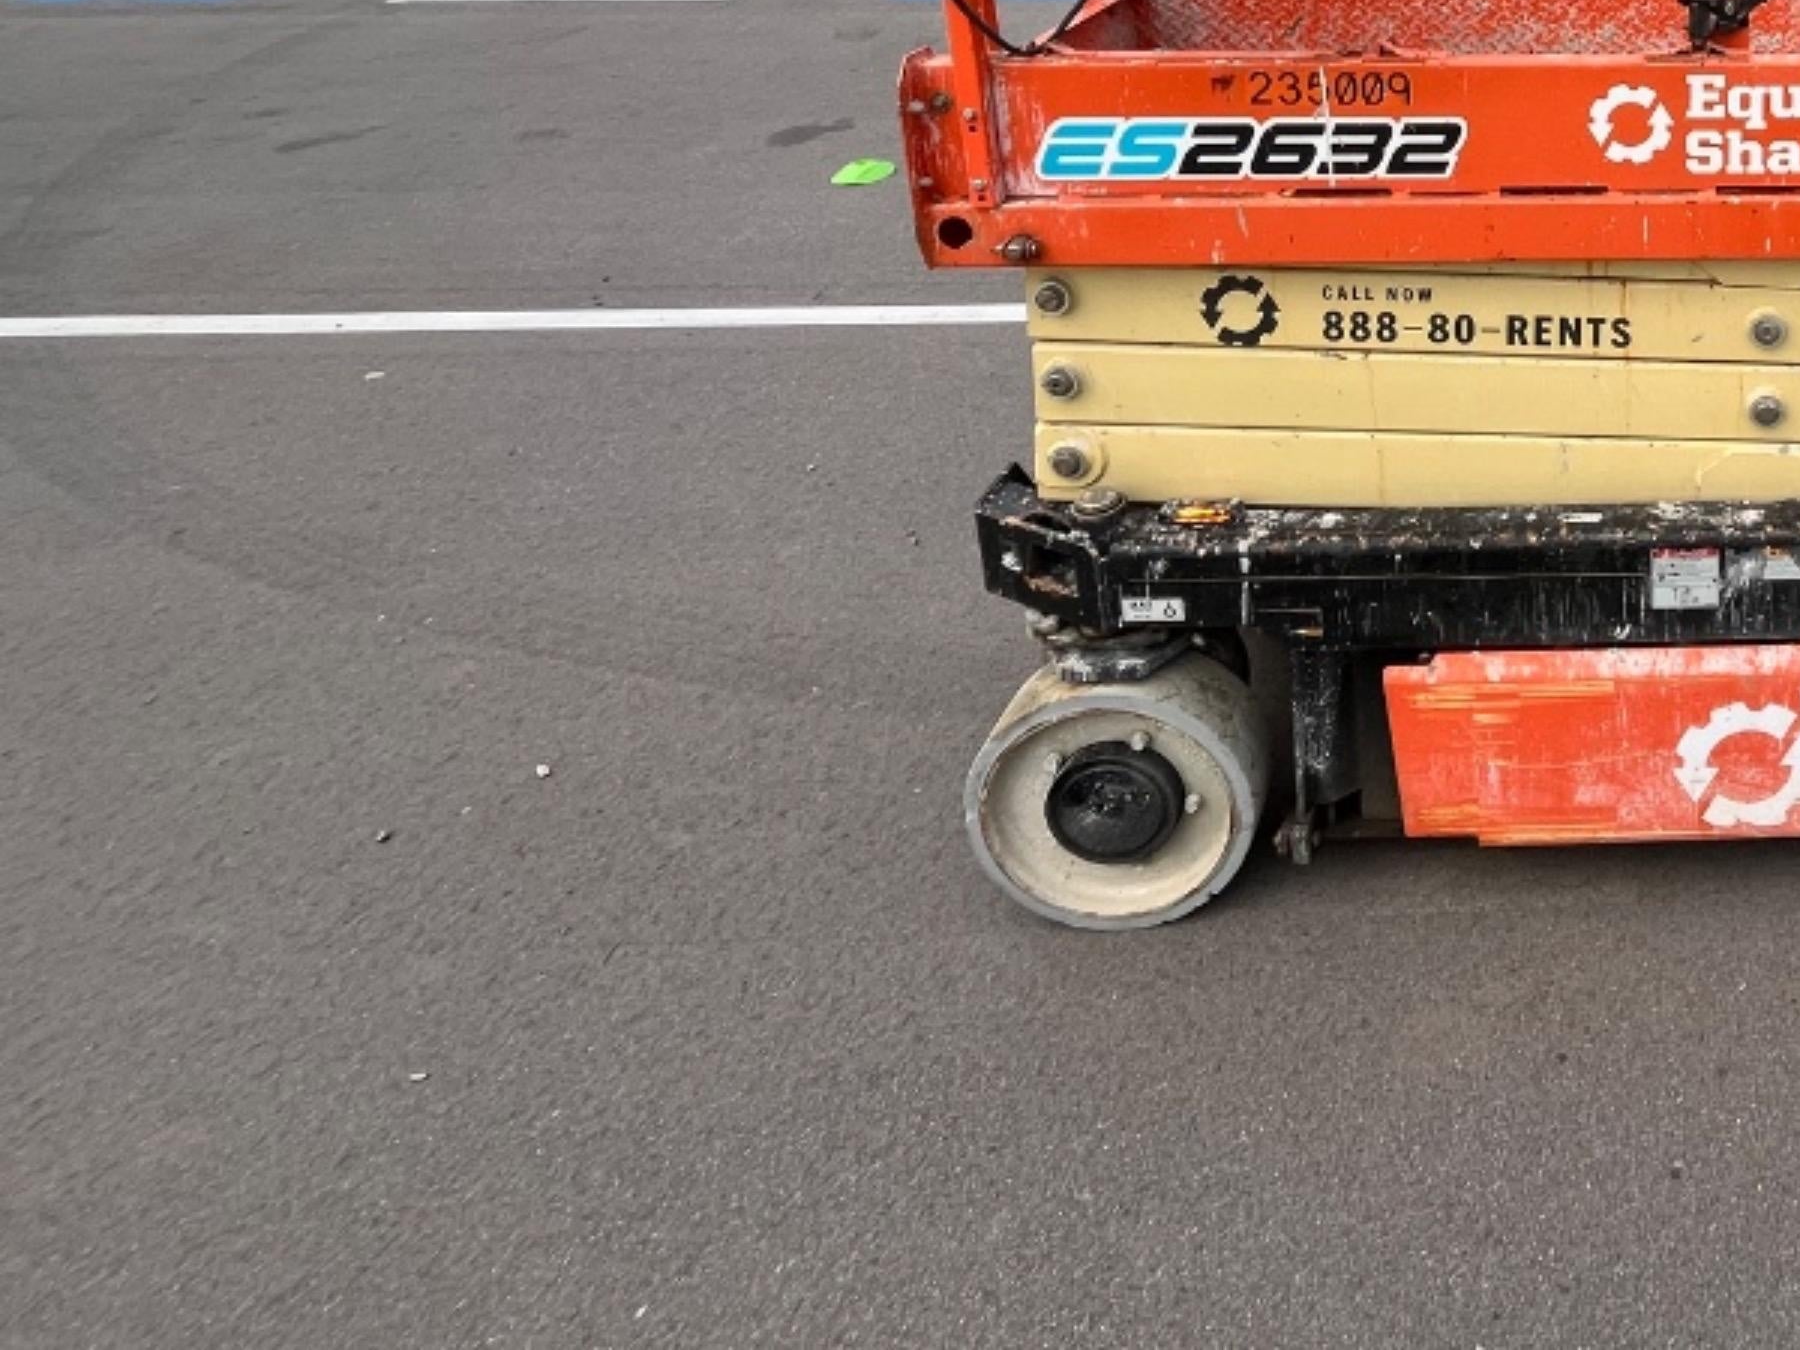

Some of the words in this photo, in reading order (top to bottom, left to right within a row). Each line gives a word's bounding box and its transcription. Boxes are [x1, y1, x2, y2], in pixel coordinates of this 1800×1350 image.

[1250, 71, 1412, 106] 235009
[1038, 119, 1464, 178] ES2632
[1322, 284, 1375, 301] CALL
[1386, 287, 1433, 302] NOW
[1322, 311, 1632, 348] 888-80-RENTS
